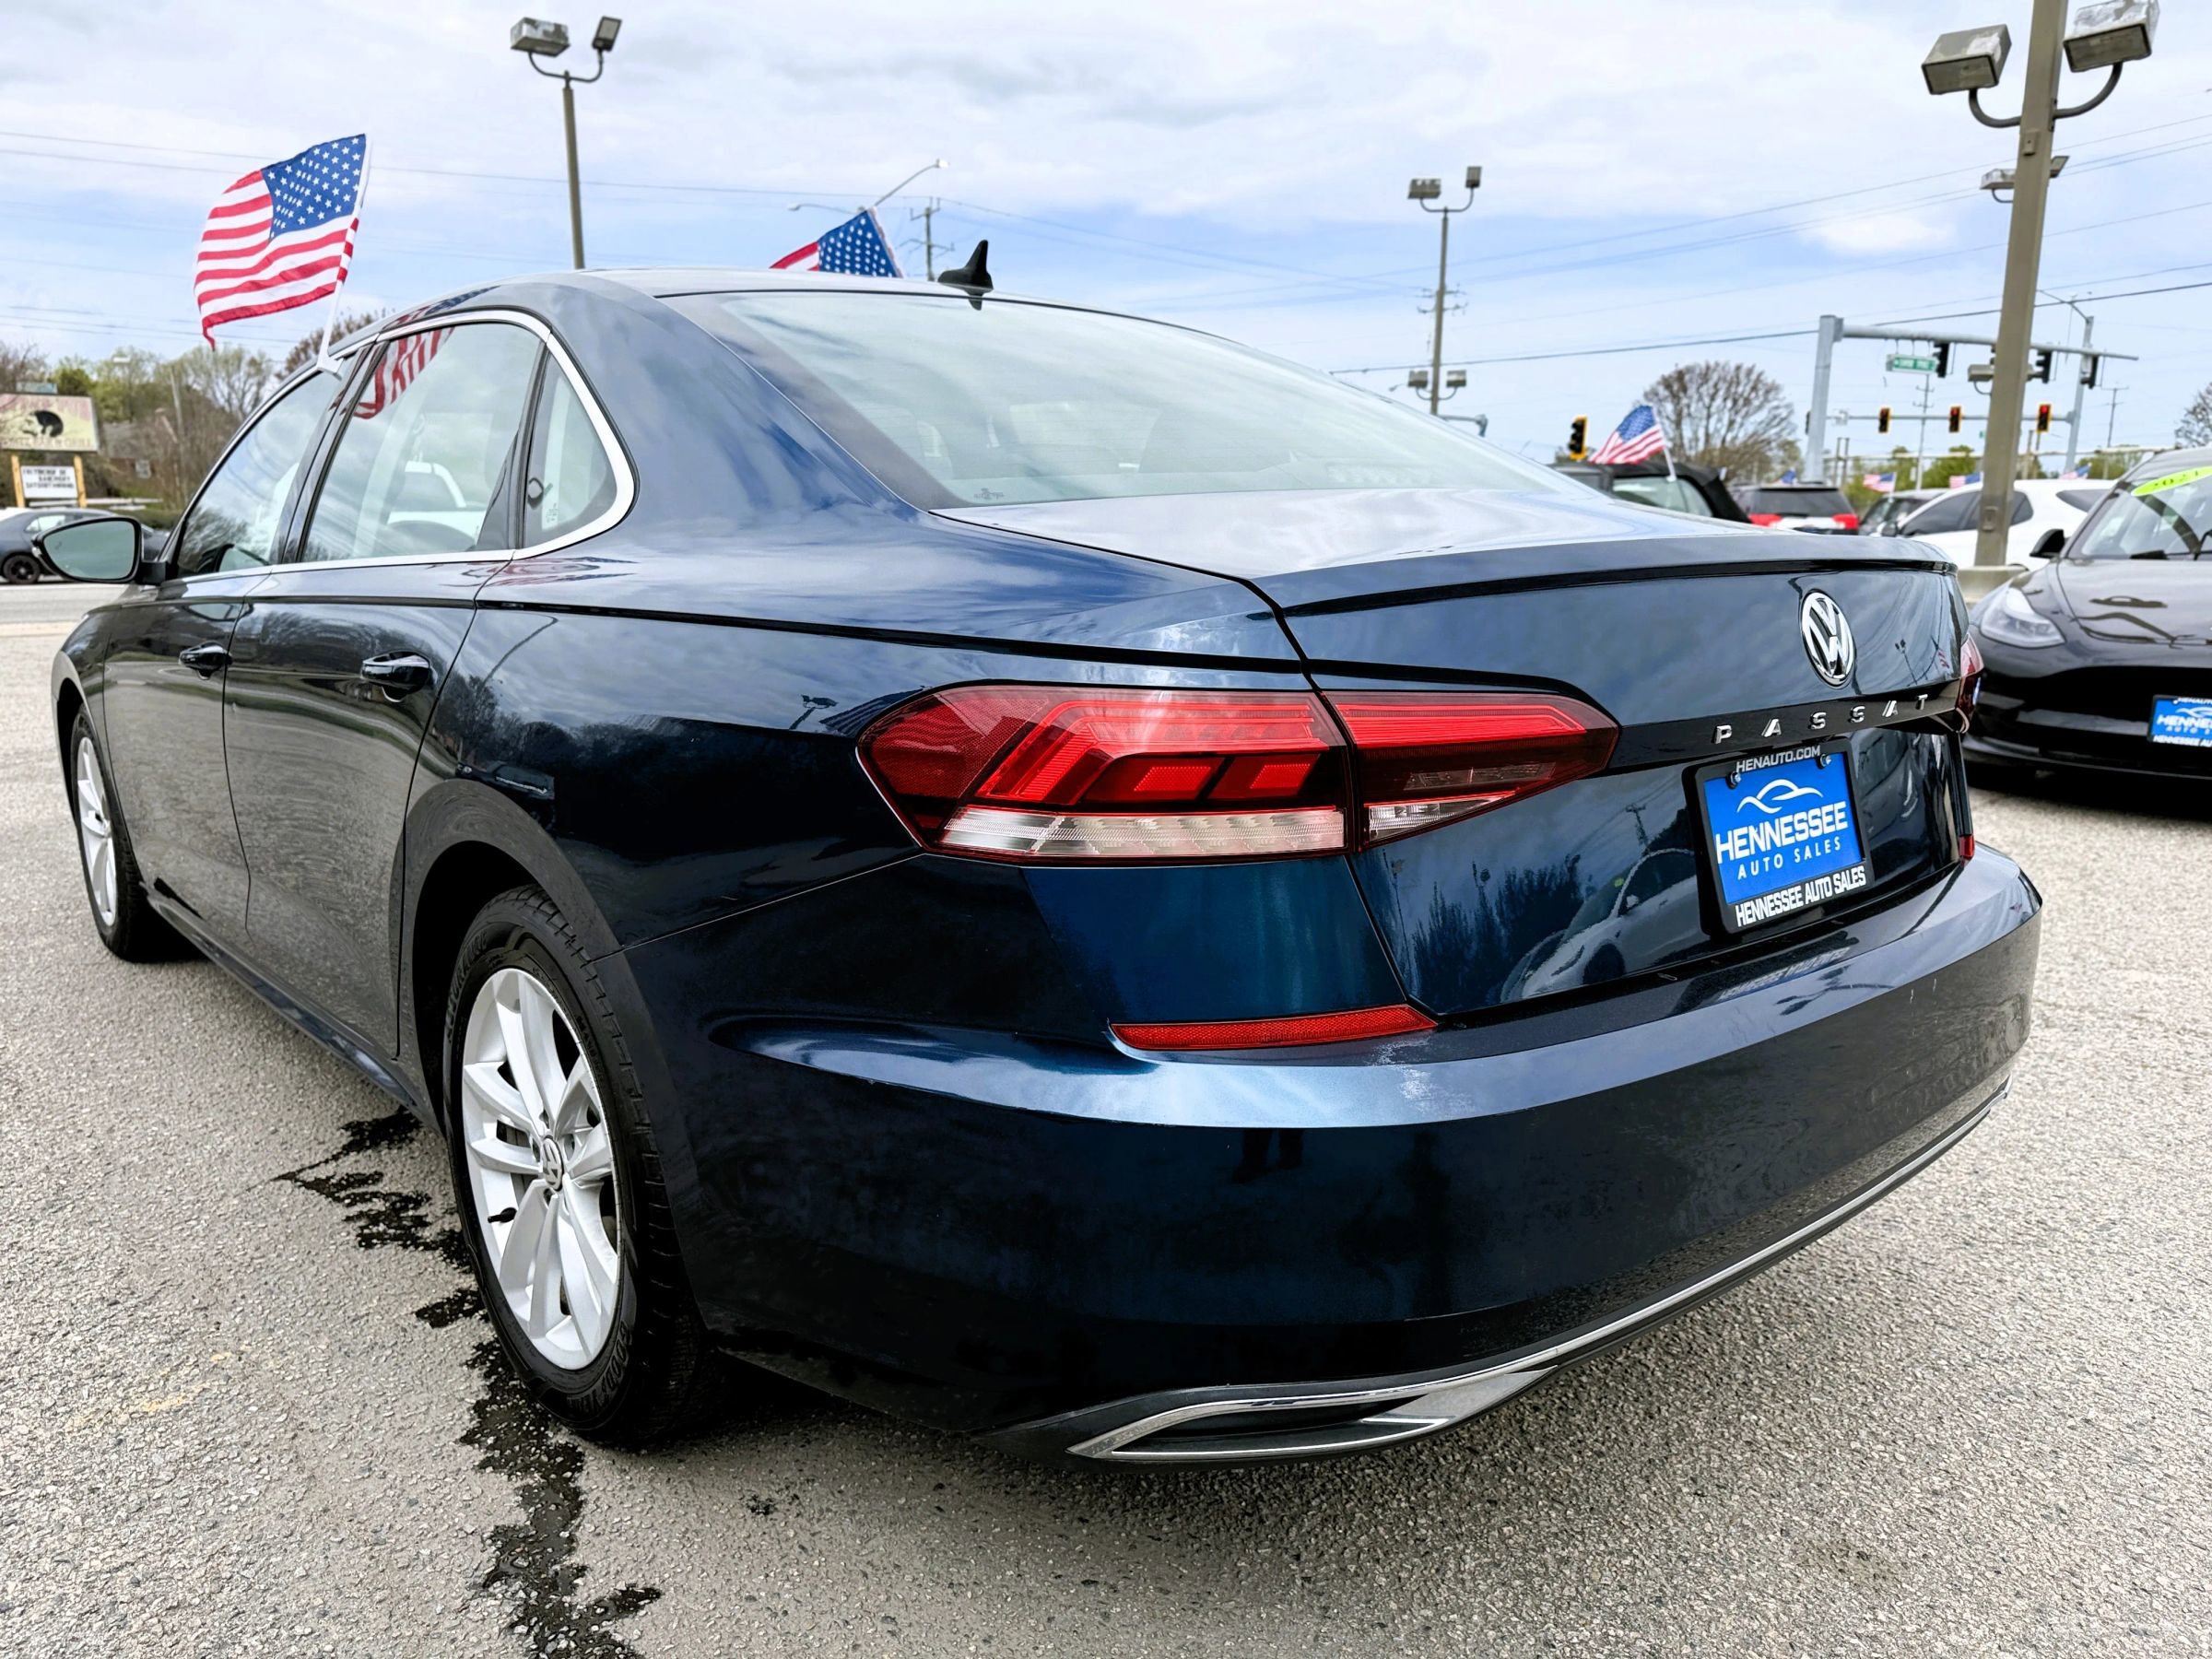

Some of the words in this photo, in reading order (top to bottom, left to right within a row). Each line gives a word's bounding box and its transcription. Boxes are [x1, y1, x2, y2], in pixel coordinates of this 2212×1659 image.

[1713, 693, 1929, 744] PASSAT
[1735, 745, 1821, 773] HENAUTO.COM
[1714, 800, 1849, 864] HENNESSEE
[1737, 853, 1783, 880] AUTO
[1794, 837, 1841, 864] SALES
[1735, 886, 1804, 927] HENNESSEE
[1805, 874, 1833, 905] AUTO
[1832, 866, 1866, 894] SALES
